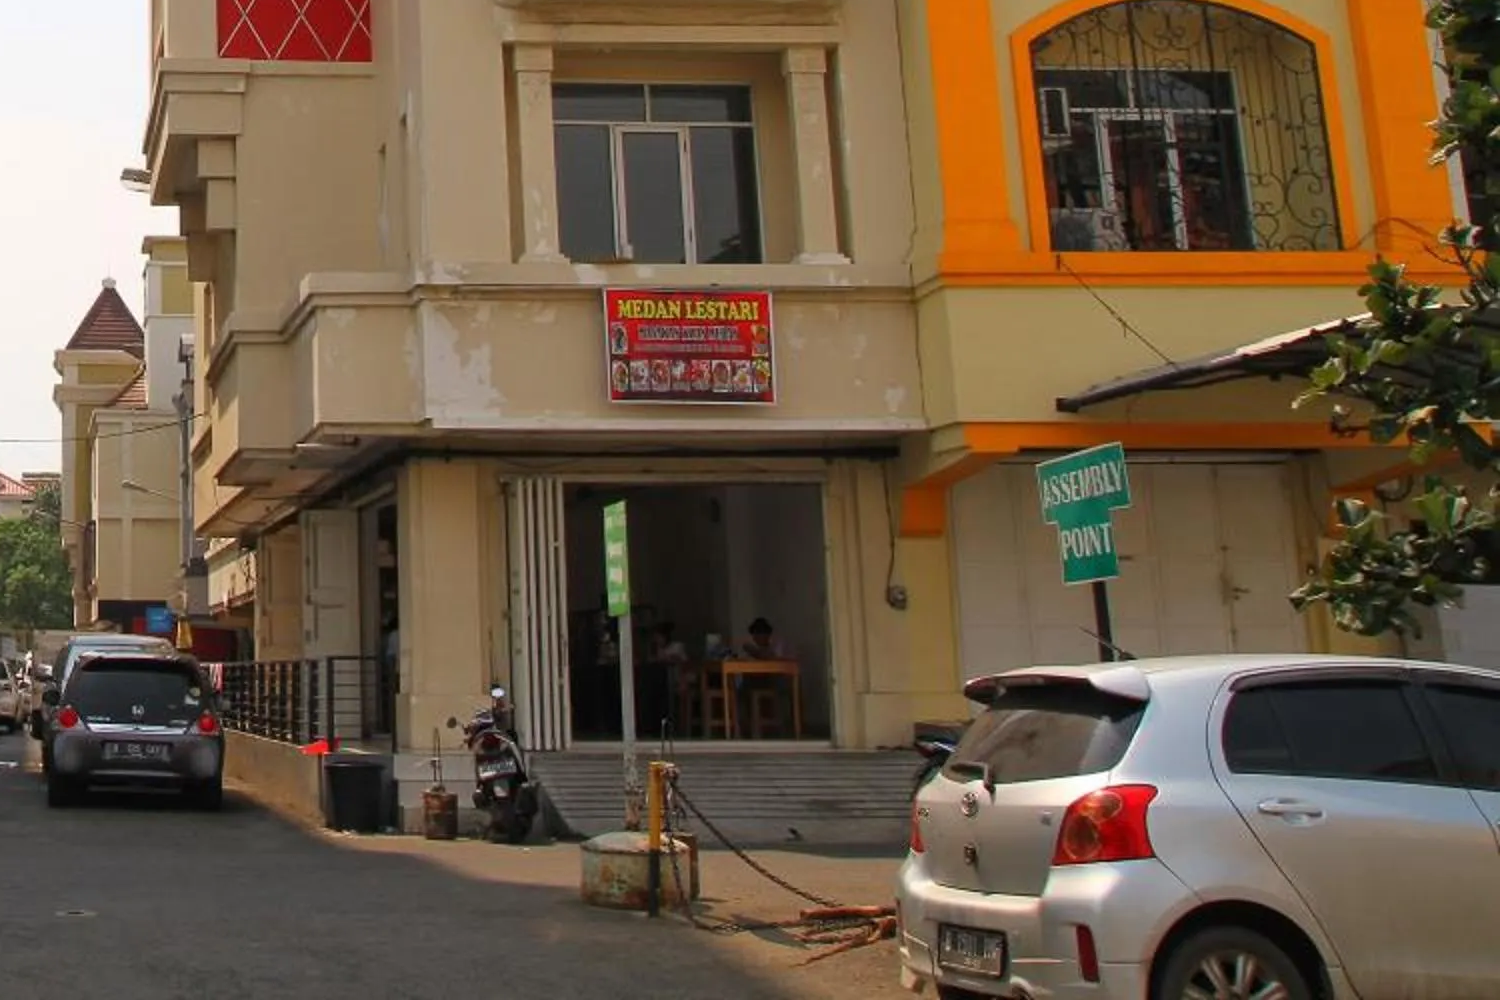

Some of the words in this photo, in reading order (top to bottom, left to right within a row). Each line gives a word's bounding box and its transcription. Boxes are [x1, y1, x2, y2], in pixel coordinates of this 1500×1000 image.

[618, 299, 681, 319] MEDAN
[685, 300, 760, 321] LESTARI
[1043, 460, 1122, 508] ASSEMBLY
[1061, 523, 1112, 561] POINT
